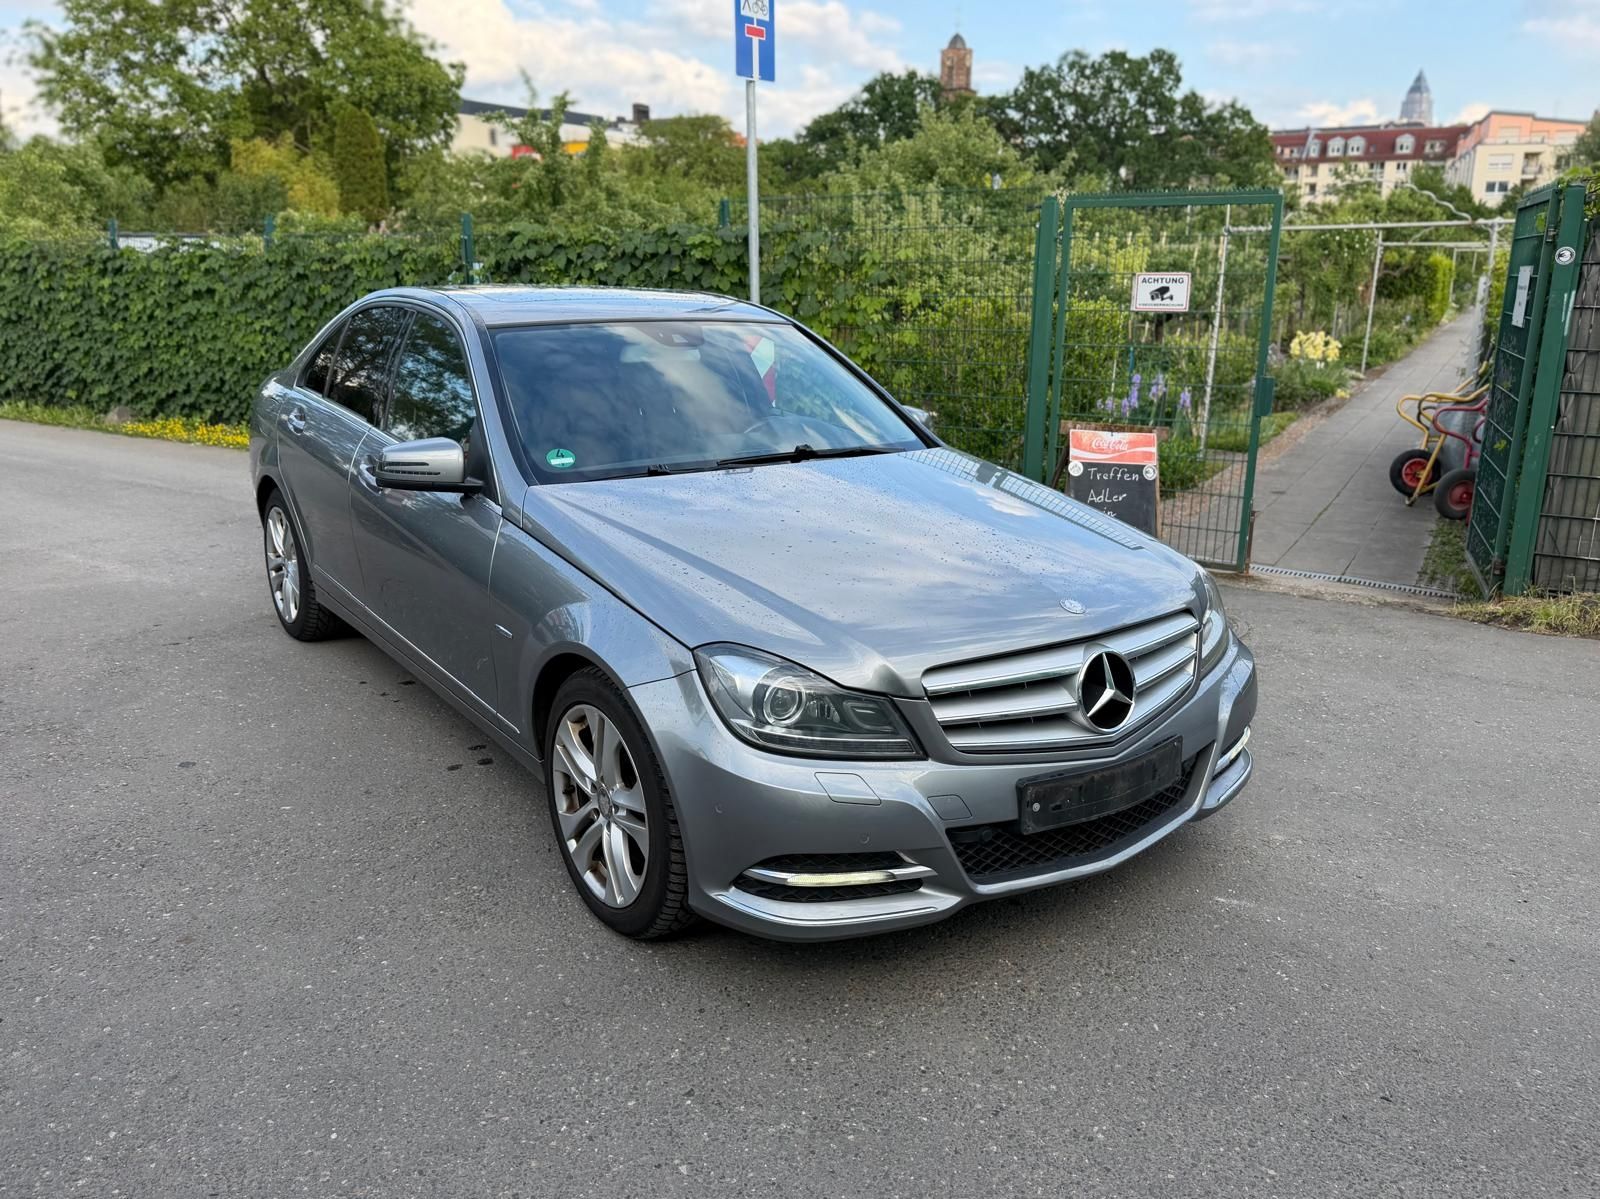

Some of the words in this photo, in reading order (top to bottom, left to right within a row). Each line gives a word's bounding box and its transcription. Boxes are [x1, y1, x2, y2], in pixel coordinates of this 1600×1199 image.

[1141, 277, 1185, 285] ACHTUNG
[556, 449, 565, 459] 4
[1087, 467, 1140, 482] Treffen
